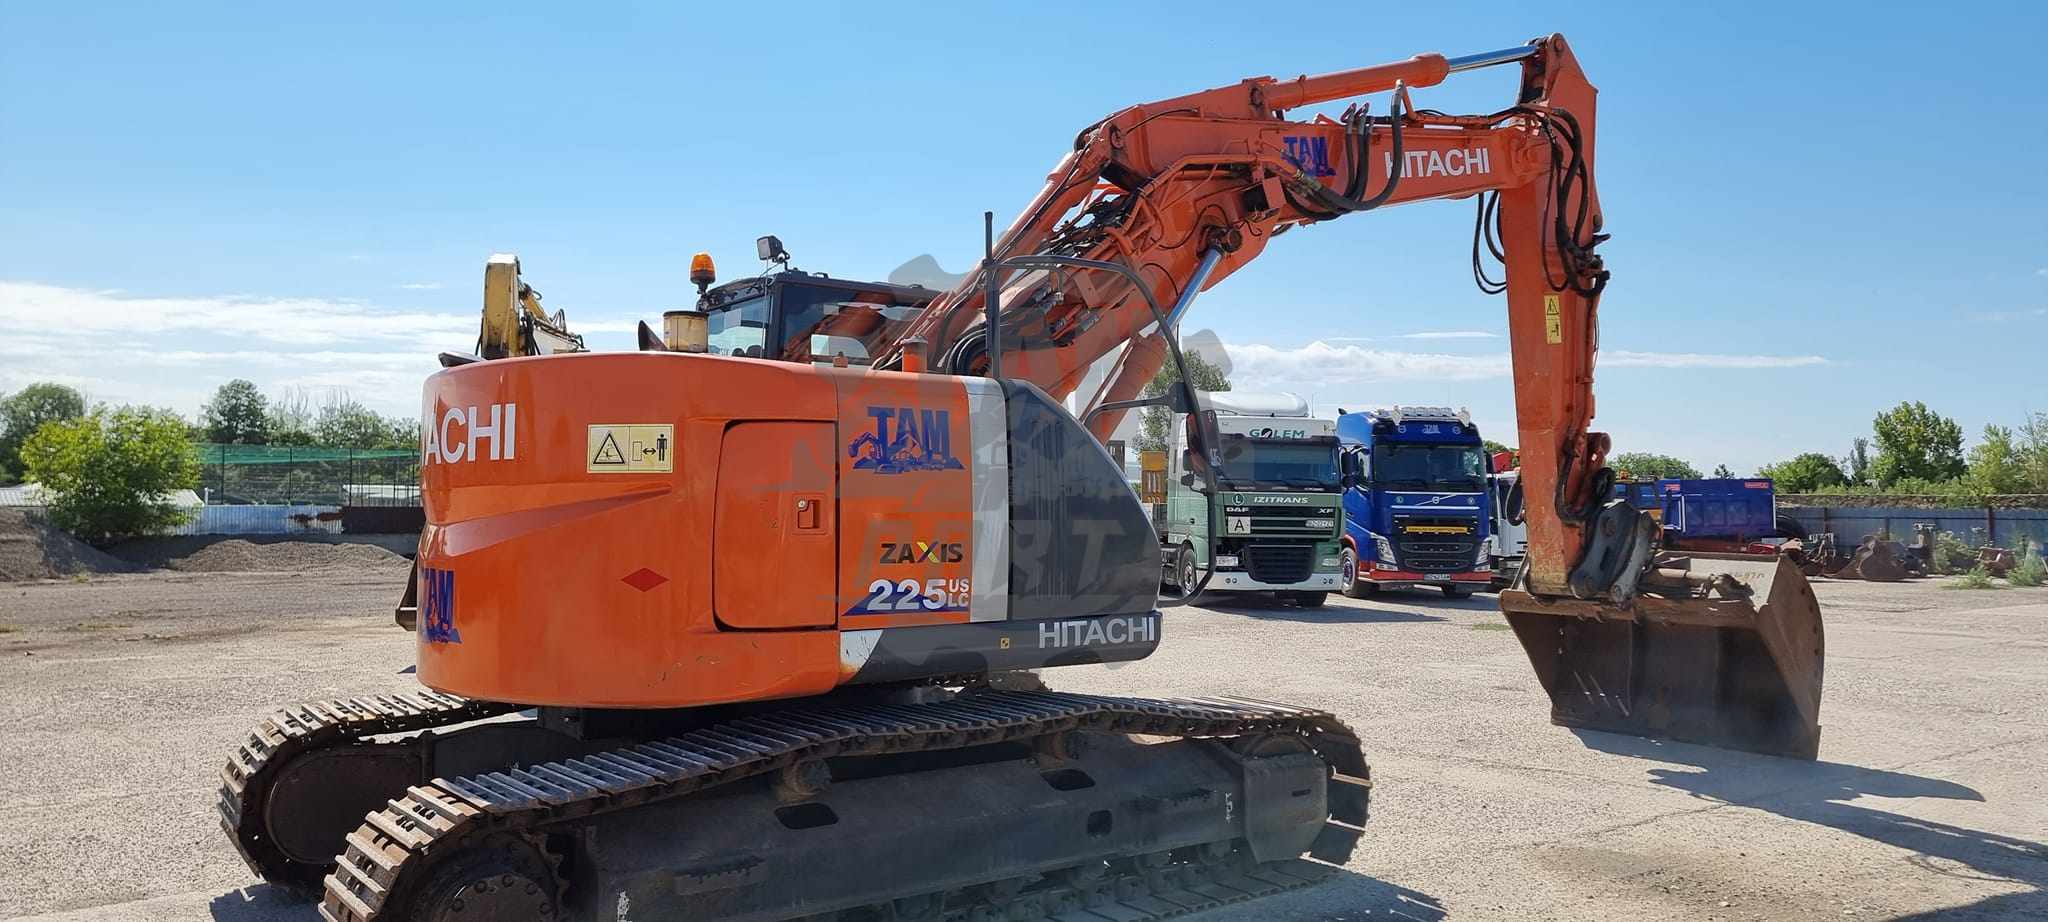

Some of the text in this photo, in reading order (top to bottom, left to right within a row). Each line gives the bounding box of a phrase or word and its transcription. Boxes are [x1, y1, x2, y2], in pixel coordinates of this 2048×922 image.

[1384, 148, 1490, 178] HITACHI
[421, 402, 517, 465] ACHI
[867, 406, 952, 464] TAM
[1249, 428, 1305, 439] GOLEM
[1253, 496, 1309, 504] IZITRANS
[1234, 519, 1245, 531] A
[879, 541, 963, 565] ZAXIS
[866, 579, 948, 611] 225
[948, 579, 969, 593] US
[948, 593, 969, 608] LC
[1038, 617, 1155, 649] HITACHI
